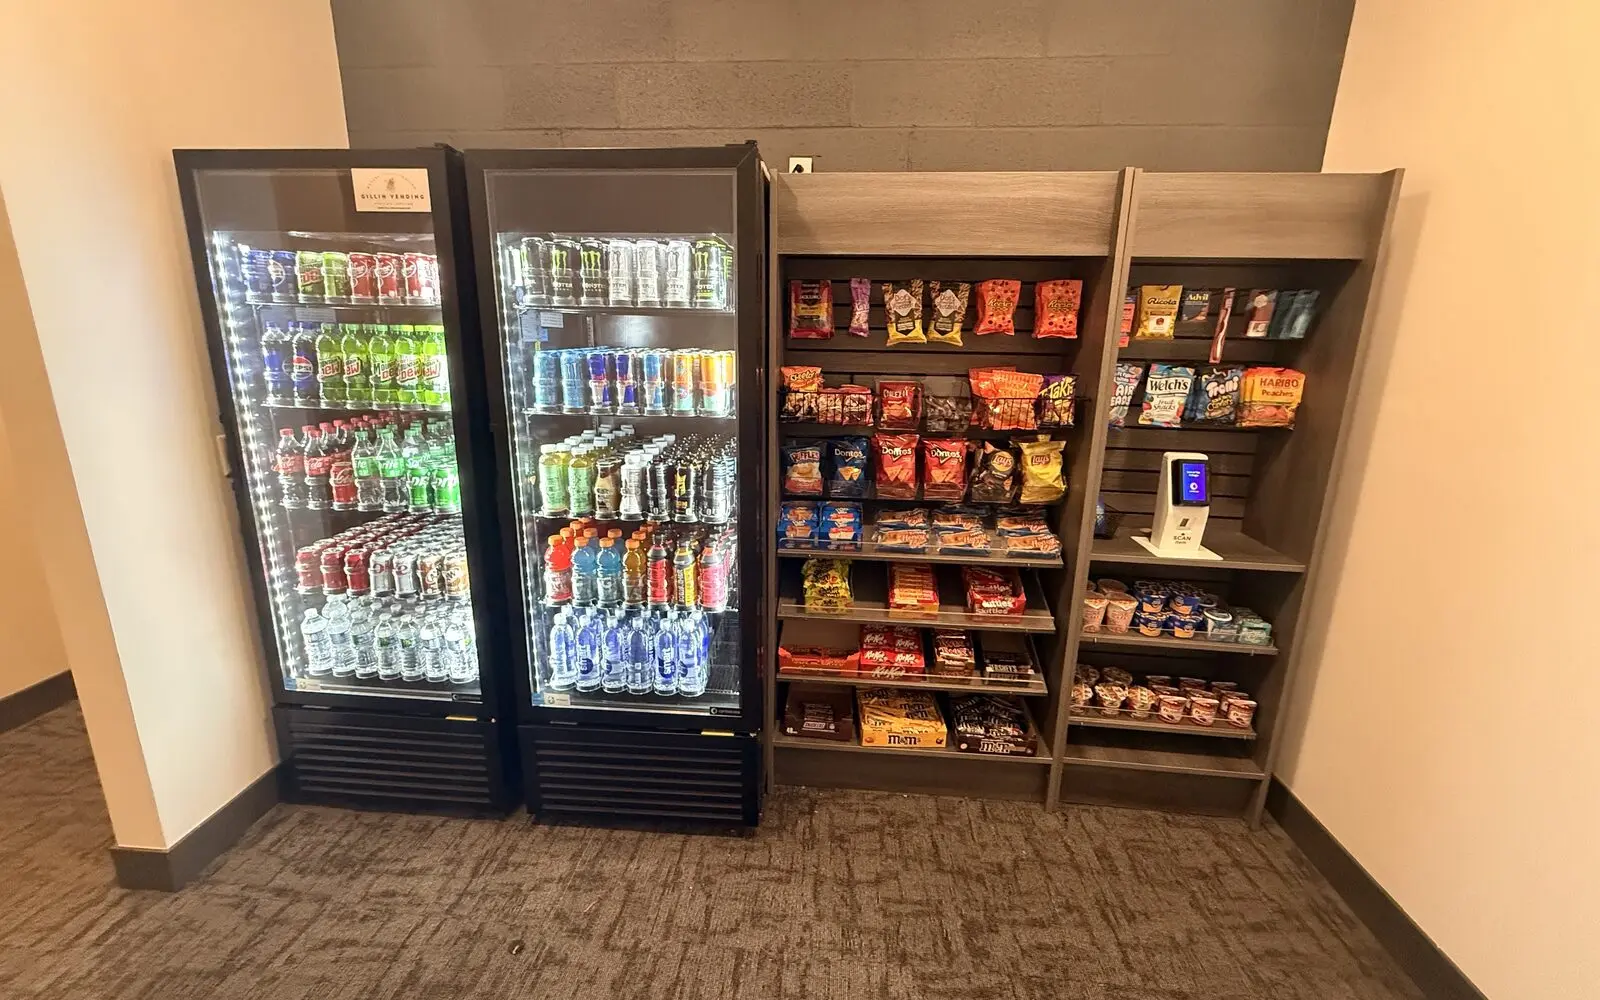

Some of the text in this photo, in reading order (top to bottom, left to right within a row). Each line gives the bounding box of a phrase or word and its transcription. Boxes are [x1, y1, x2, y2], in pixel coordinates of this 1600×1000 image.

[1147, 297, 1177, 305] Ricola
[1188, 293, 1209, 301] Advil
[1150, 379, 1189, 391] Welch's
[1260, 378, 1299, 387] HARIBO
[881, 447, 912, 456] Doritos
